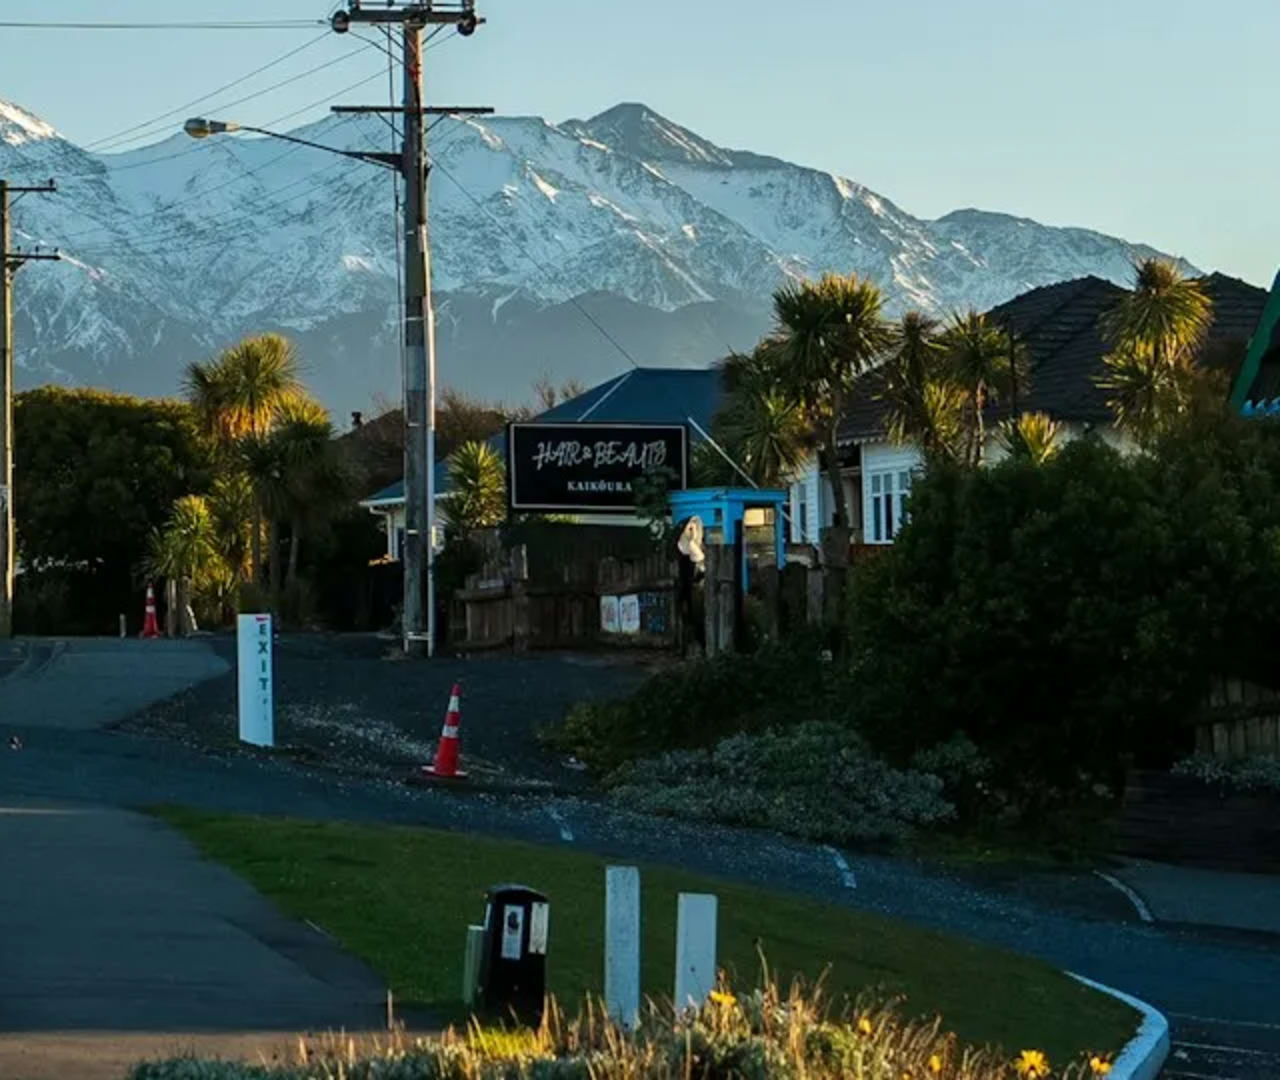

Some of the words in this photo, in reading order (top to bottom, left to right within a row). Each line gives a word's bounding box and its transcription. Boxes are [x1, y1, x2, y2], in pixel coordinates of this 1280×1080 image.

[532, 440, 582, 471] HAIR
[593, 439, 667, 469] BEAUTY
[258, 624, 269, 690] EXIT
